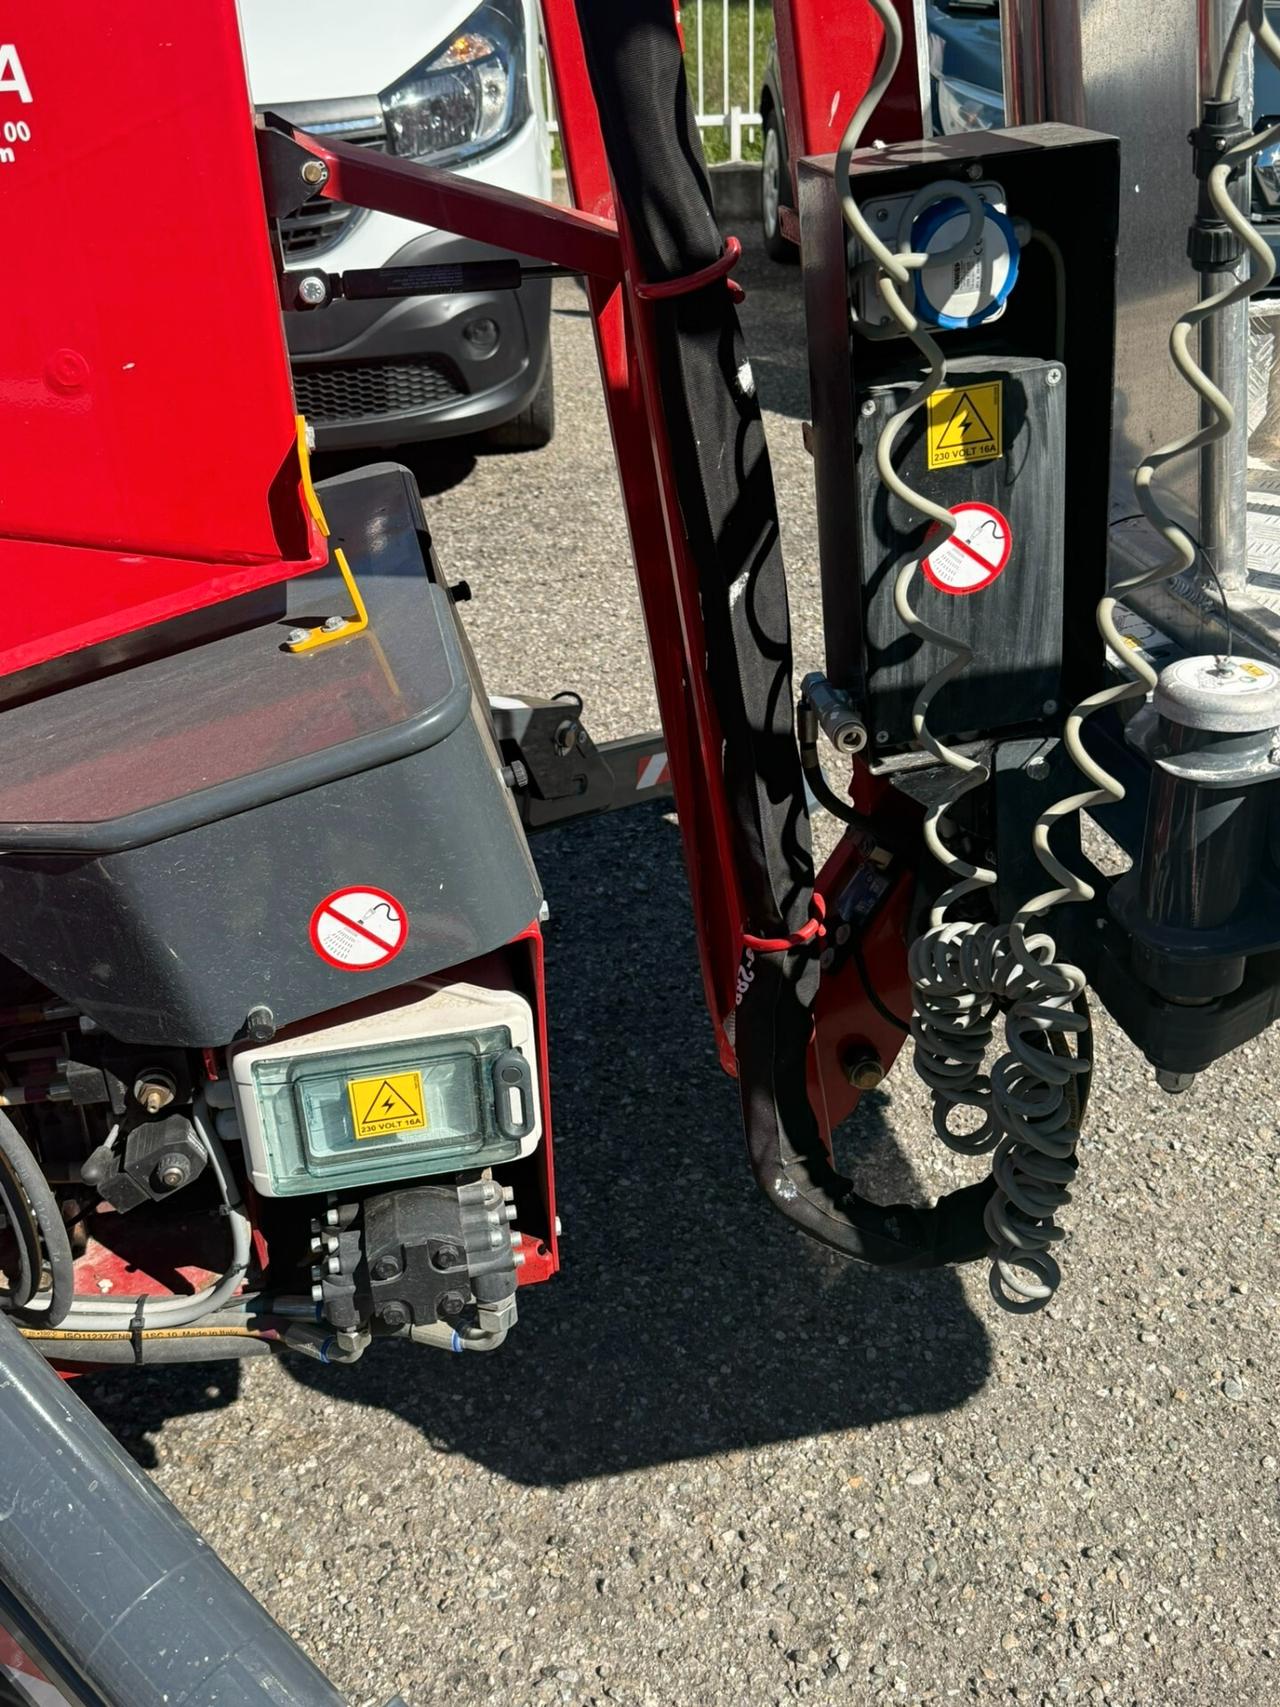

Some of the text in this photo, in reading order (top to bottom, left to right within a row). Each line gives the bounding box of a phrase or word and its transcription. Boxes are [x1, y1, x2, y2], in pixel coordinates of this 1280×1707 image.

[0, 44, 33, 103] A
[4, 121, 31, 142] 00
[934, 444, 997, 461] 230 VOLT 16A
[360, 1118, 422, 1133] 230 VOLT 16A
[63, 1332, 132, 1340] ISO11237/EN8
[182, 1330, 204, 1338] Made
